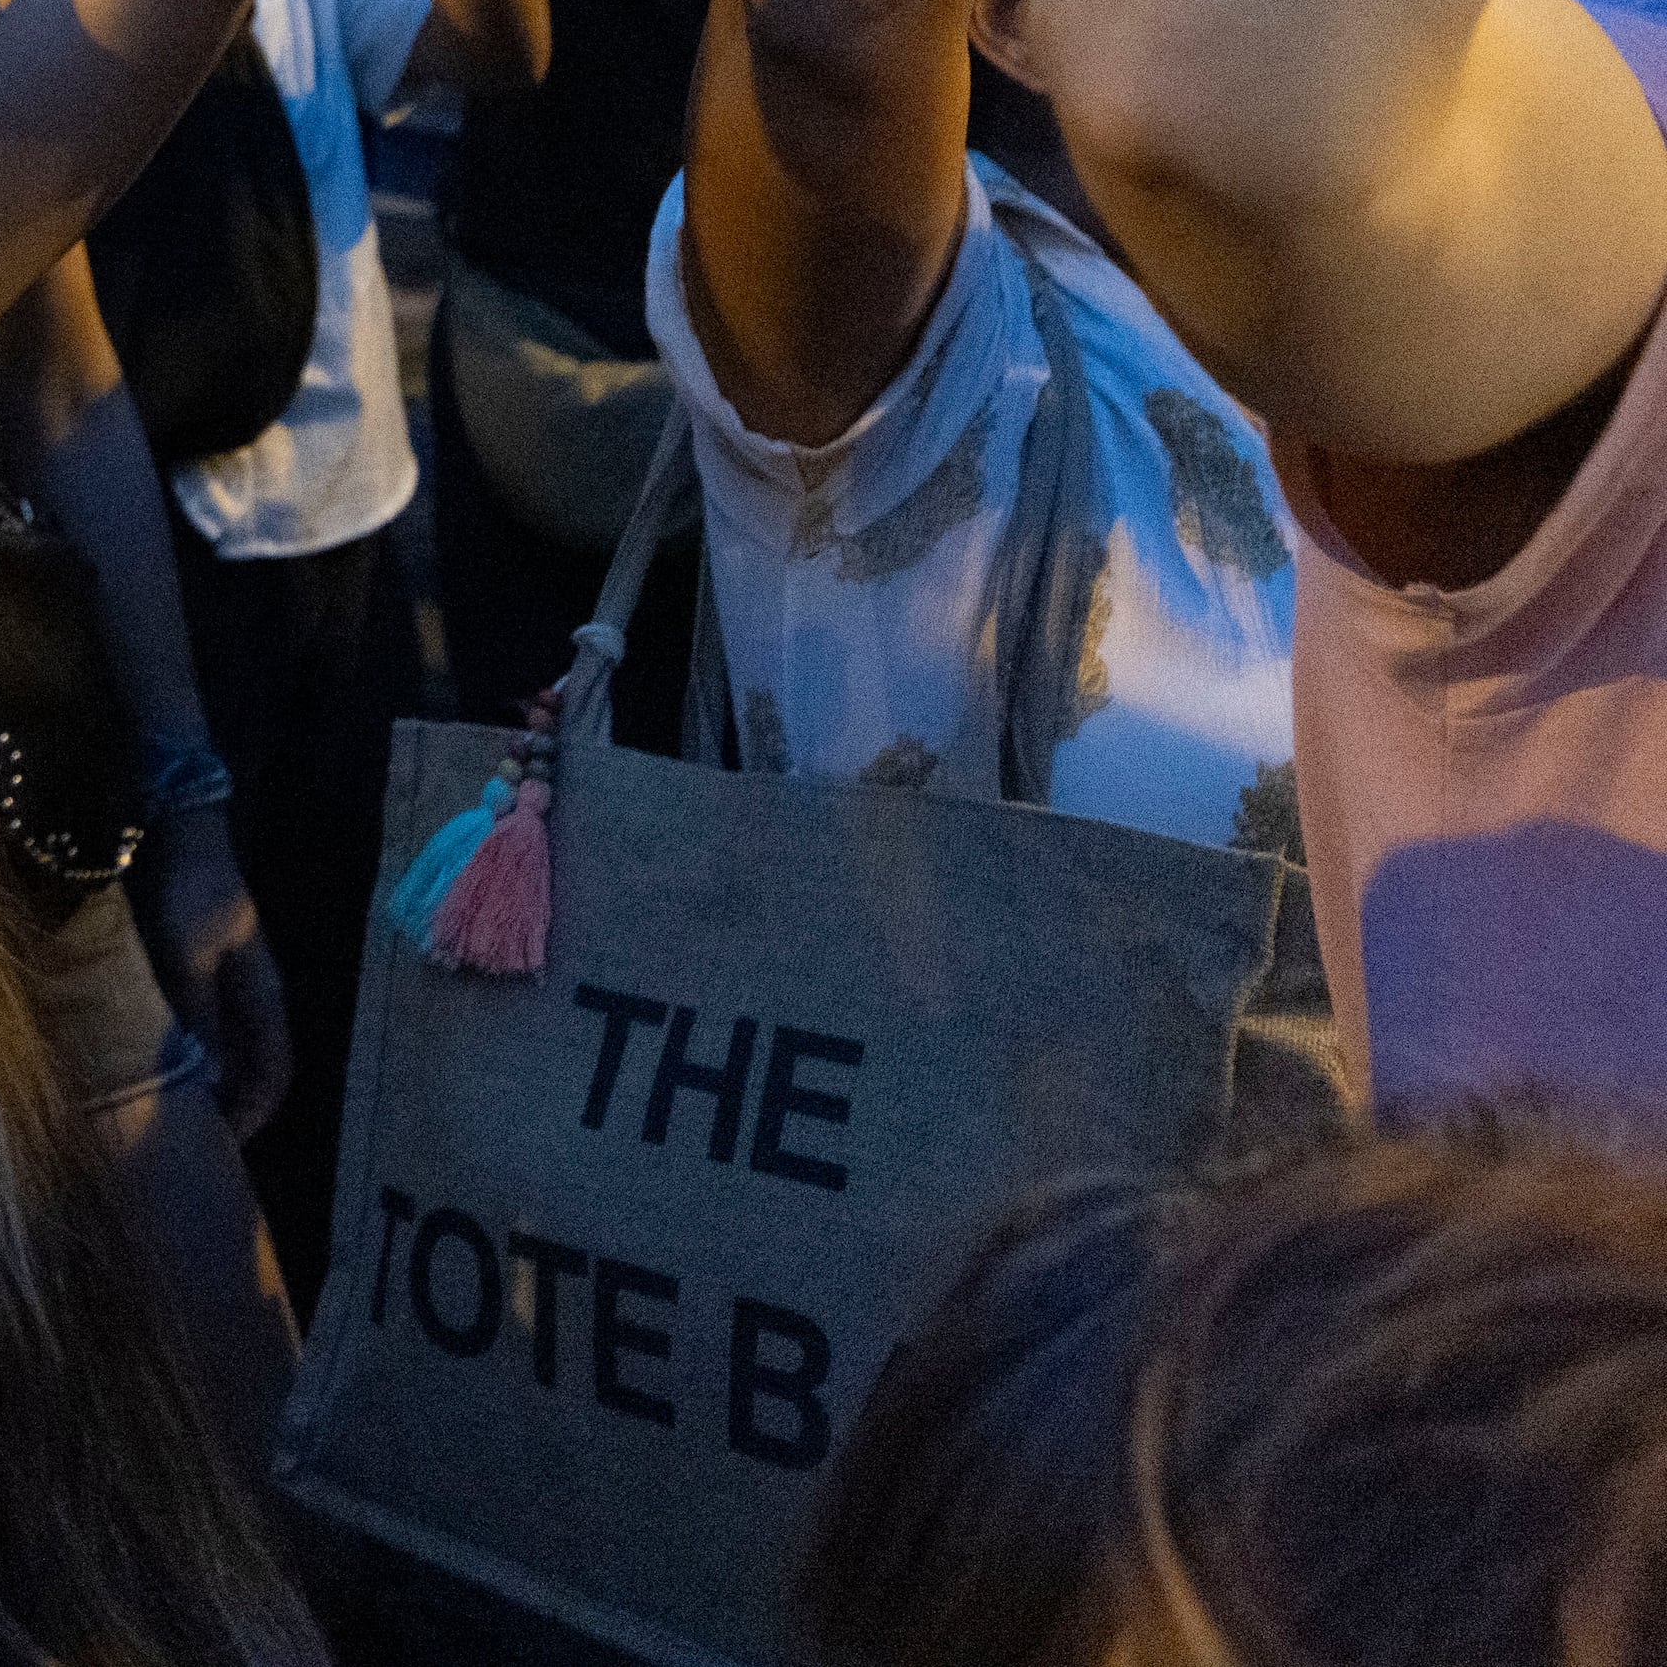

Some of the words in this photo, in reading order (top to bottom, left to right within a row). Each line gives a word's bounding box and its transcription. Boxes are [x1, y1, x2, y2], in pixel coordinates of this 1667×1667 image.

[574, 983, 864, 1190] THE
[372, 1189, 679, 1427] TOTE
[728, 1298, 831, 1470] B
